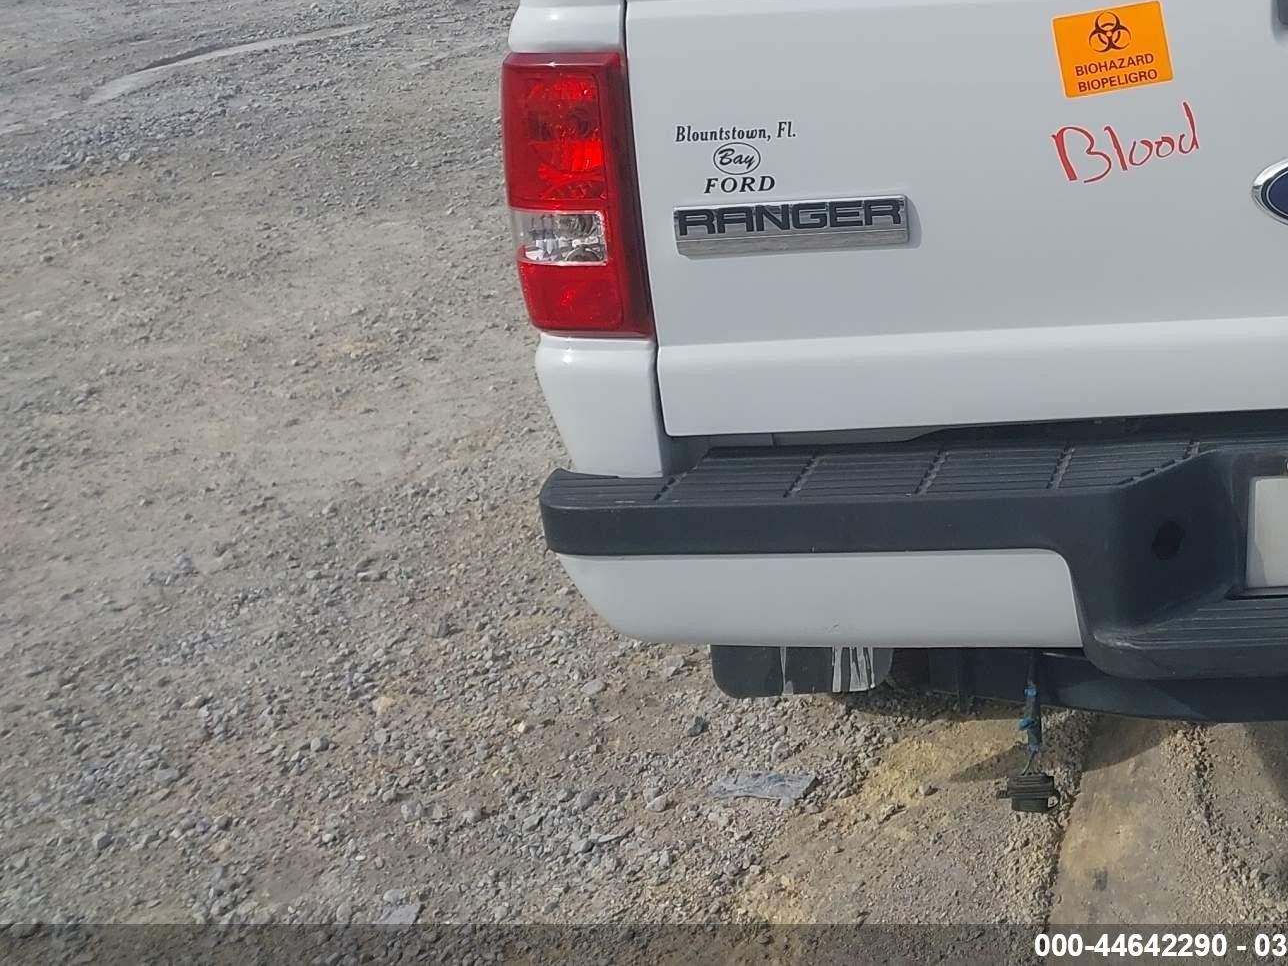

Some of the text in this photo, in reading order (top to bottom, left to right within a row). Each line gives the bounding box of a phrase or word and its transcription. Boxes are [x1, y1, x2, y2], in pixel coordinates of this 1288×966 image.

[1074, 53, 1155, 77] BIOHAZARD
[1077, 68, 1159, 93] BIOPELIGRO
[675, 121, 797, 143] Blountstown, Fl.
[1050, 102, 1200, 184] Blood
[717, 148, 757, 169] Bay
[703, 175, 776, 194] FORD
[678, 199, 903, 236] RANGER
